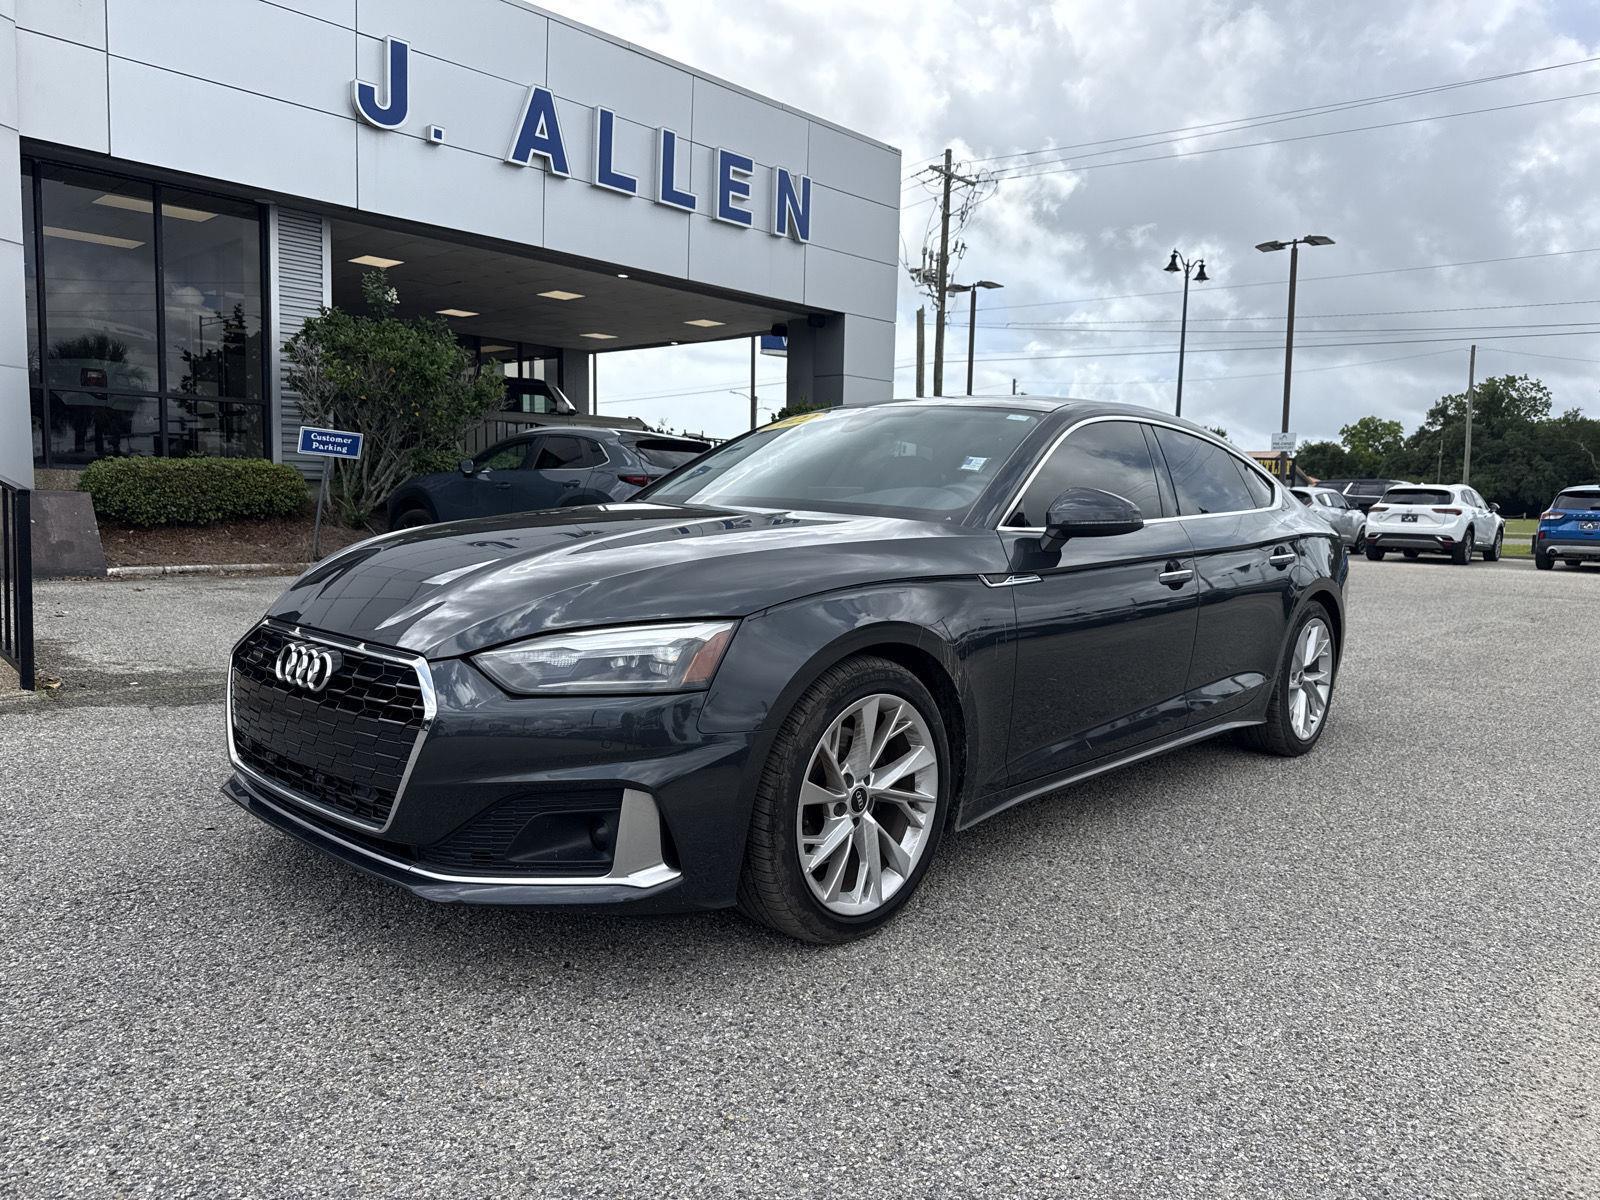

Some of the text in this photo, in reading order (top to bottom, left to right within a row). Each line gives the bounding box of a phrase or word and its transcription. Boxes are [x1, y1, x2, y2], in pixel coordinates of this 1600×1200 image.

[351, 35, 813, 244] J. ALLEN
[310, 432, 352, 444] Customer
[312, 441, 348, 453] Parking
